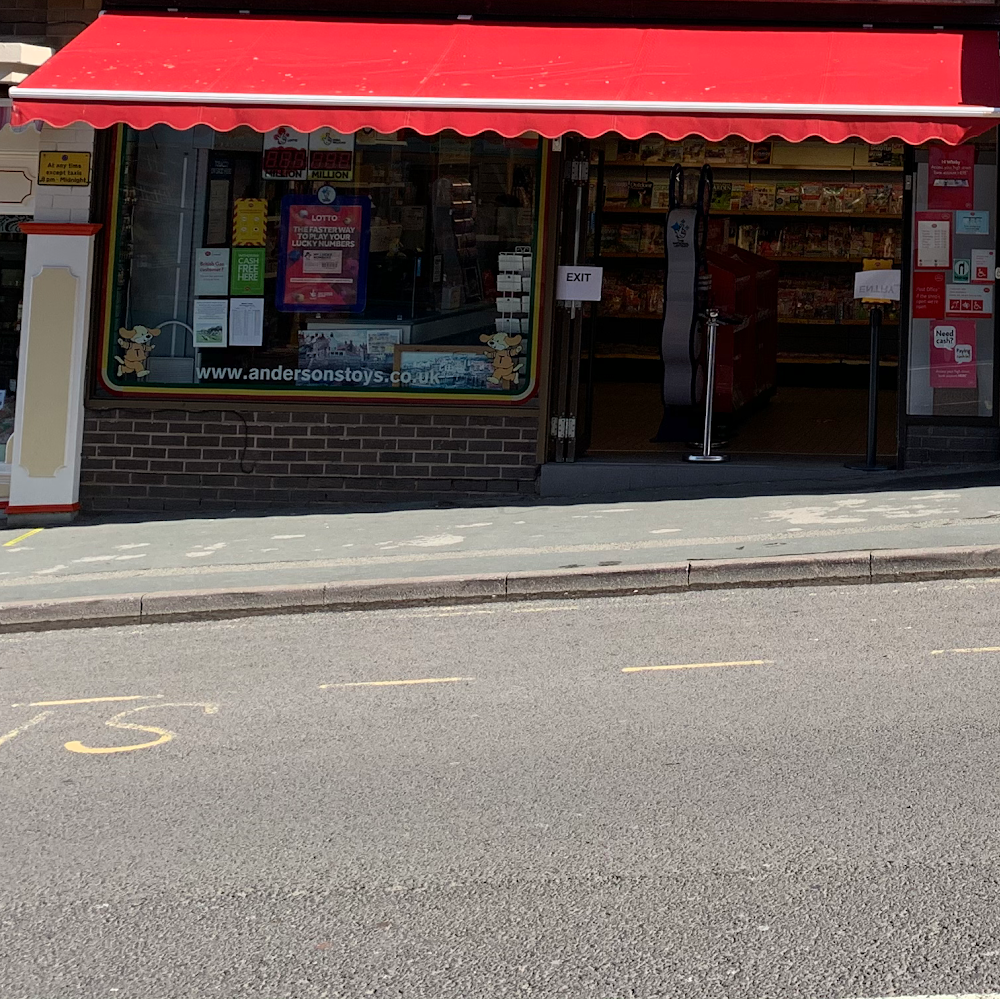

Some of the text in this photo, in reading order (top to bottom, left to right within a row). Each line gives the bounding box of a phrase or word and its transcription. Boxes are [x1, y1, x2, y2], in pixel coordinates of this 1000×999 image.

[312, 171, 349, 179] MILLION
[311, 214, 338, 222] LOTTO
[238, 265, 259, 273] FREE
[237, 273, 258, 281] HERE
[566, 272, 592, 282] EXIT
[196, 364, 440, 385] www.andersonstoys.co.uk
